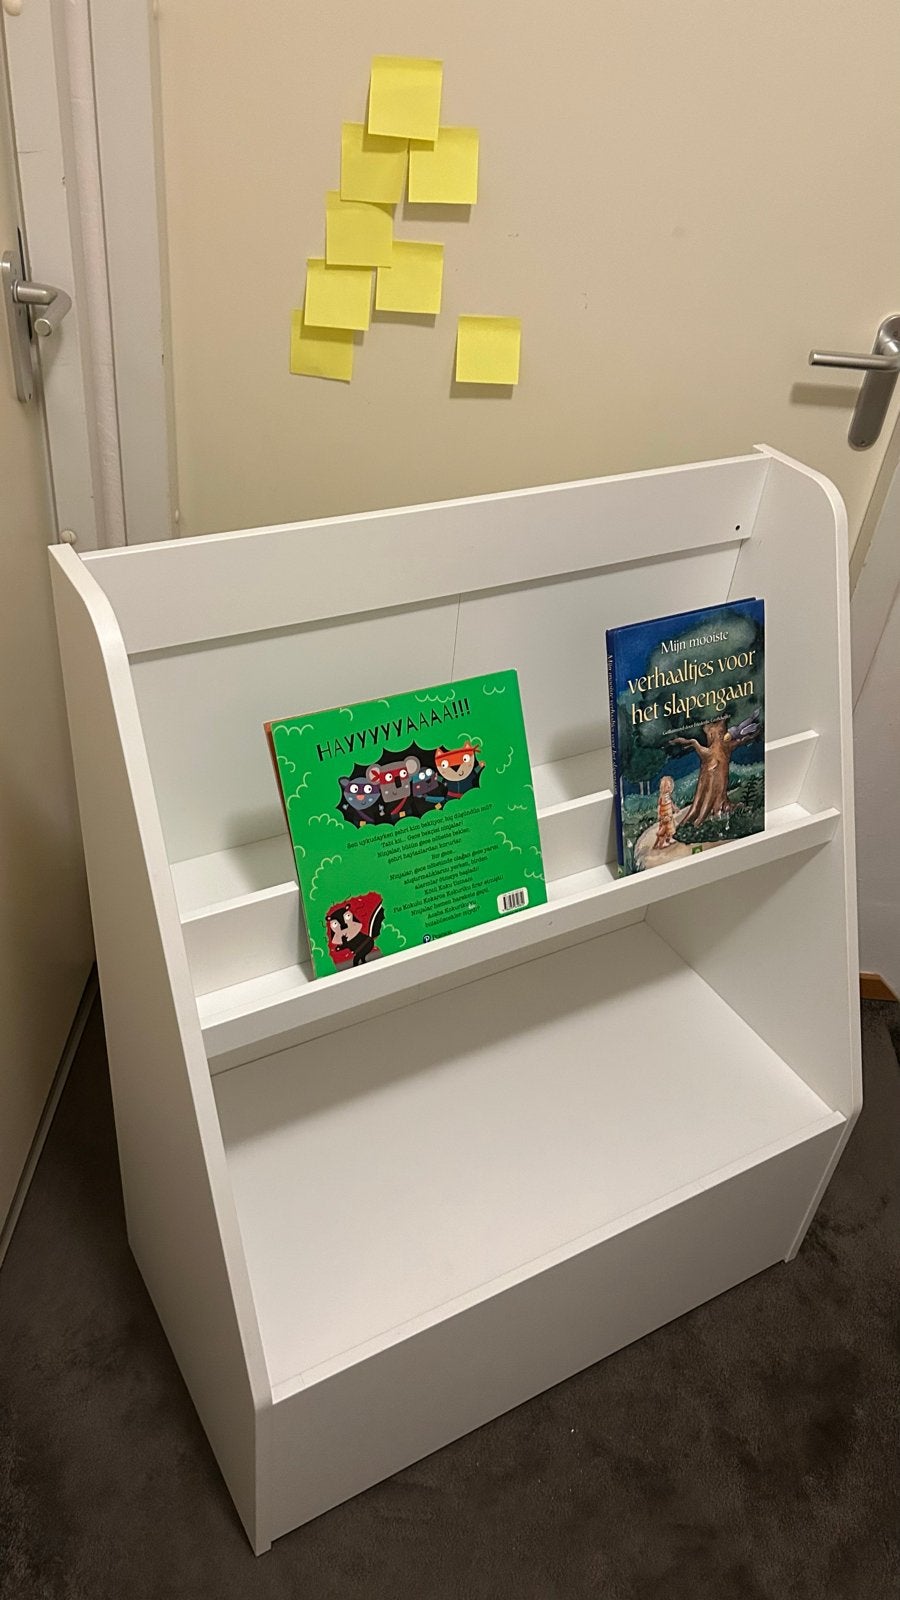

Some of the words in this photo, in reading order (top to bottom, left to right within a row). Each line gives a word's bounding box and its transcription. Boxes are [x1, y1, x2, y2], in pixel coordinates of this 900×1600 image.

[661, 639, 686, 655] Mijn
[689, 631, 729, 648] mooiste
[627, 659, 714, 694] verhaaltjes
[717, 650, 756, 673] voor
[631, 702, 659, 725] het
[663, 680, 754, 719] slapengaan
[316, 698, 470, 762] HAYYYYYAAAA!!!
[419, 838, 431, 846] gece
